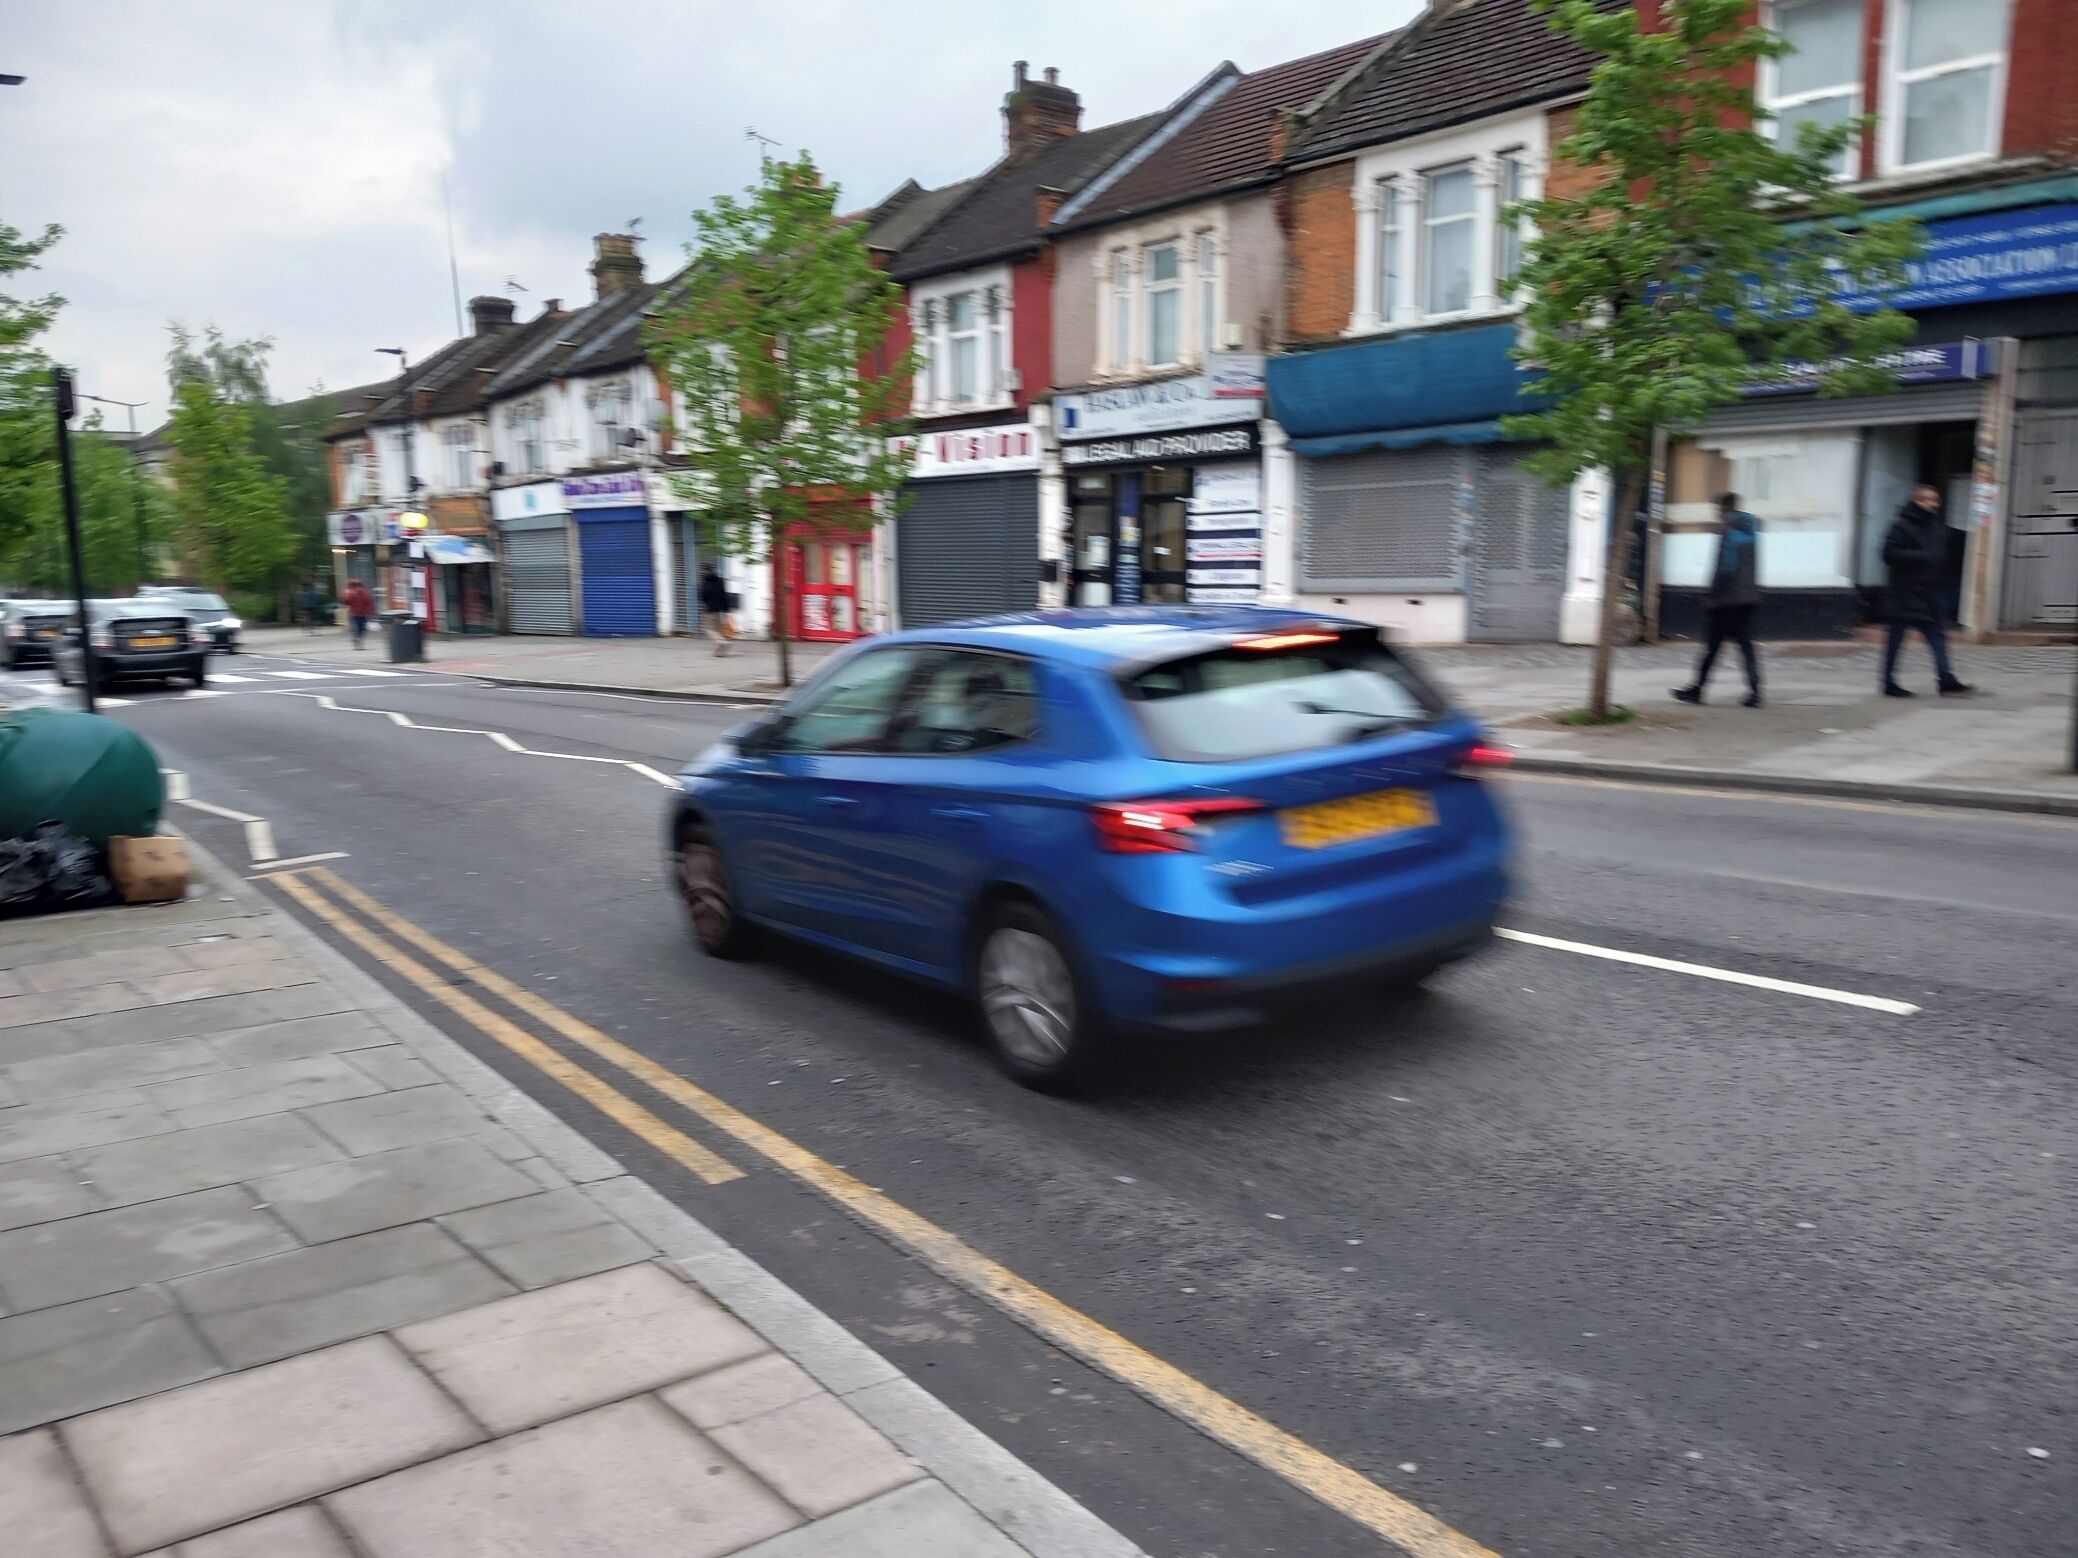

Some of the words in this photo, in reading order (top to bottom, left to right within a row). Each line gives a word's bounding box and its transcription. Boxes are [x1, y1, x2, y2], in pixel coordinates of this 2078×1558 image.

[1085, 441, 1133, 462] LEGAL
[1134, 438, 1161, 457] AID
[1163, 430, 1250, 456] PROVIDER
